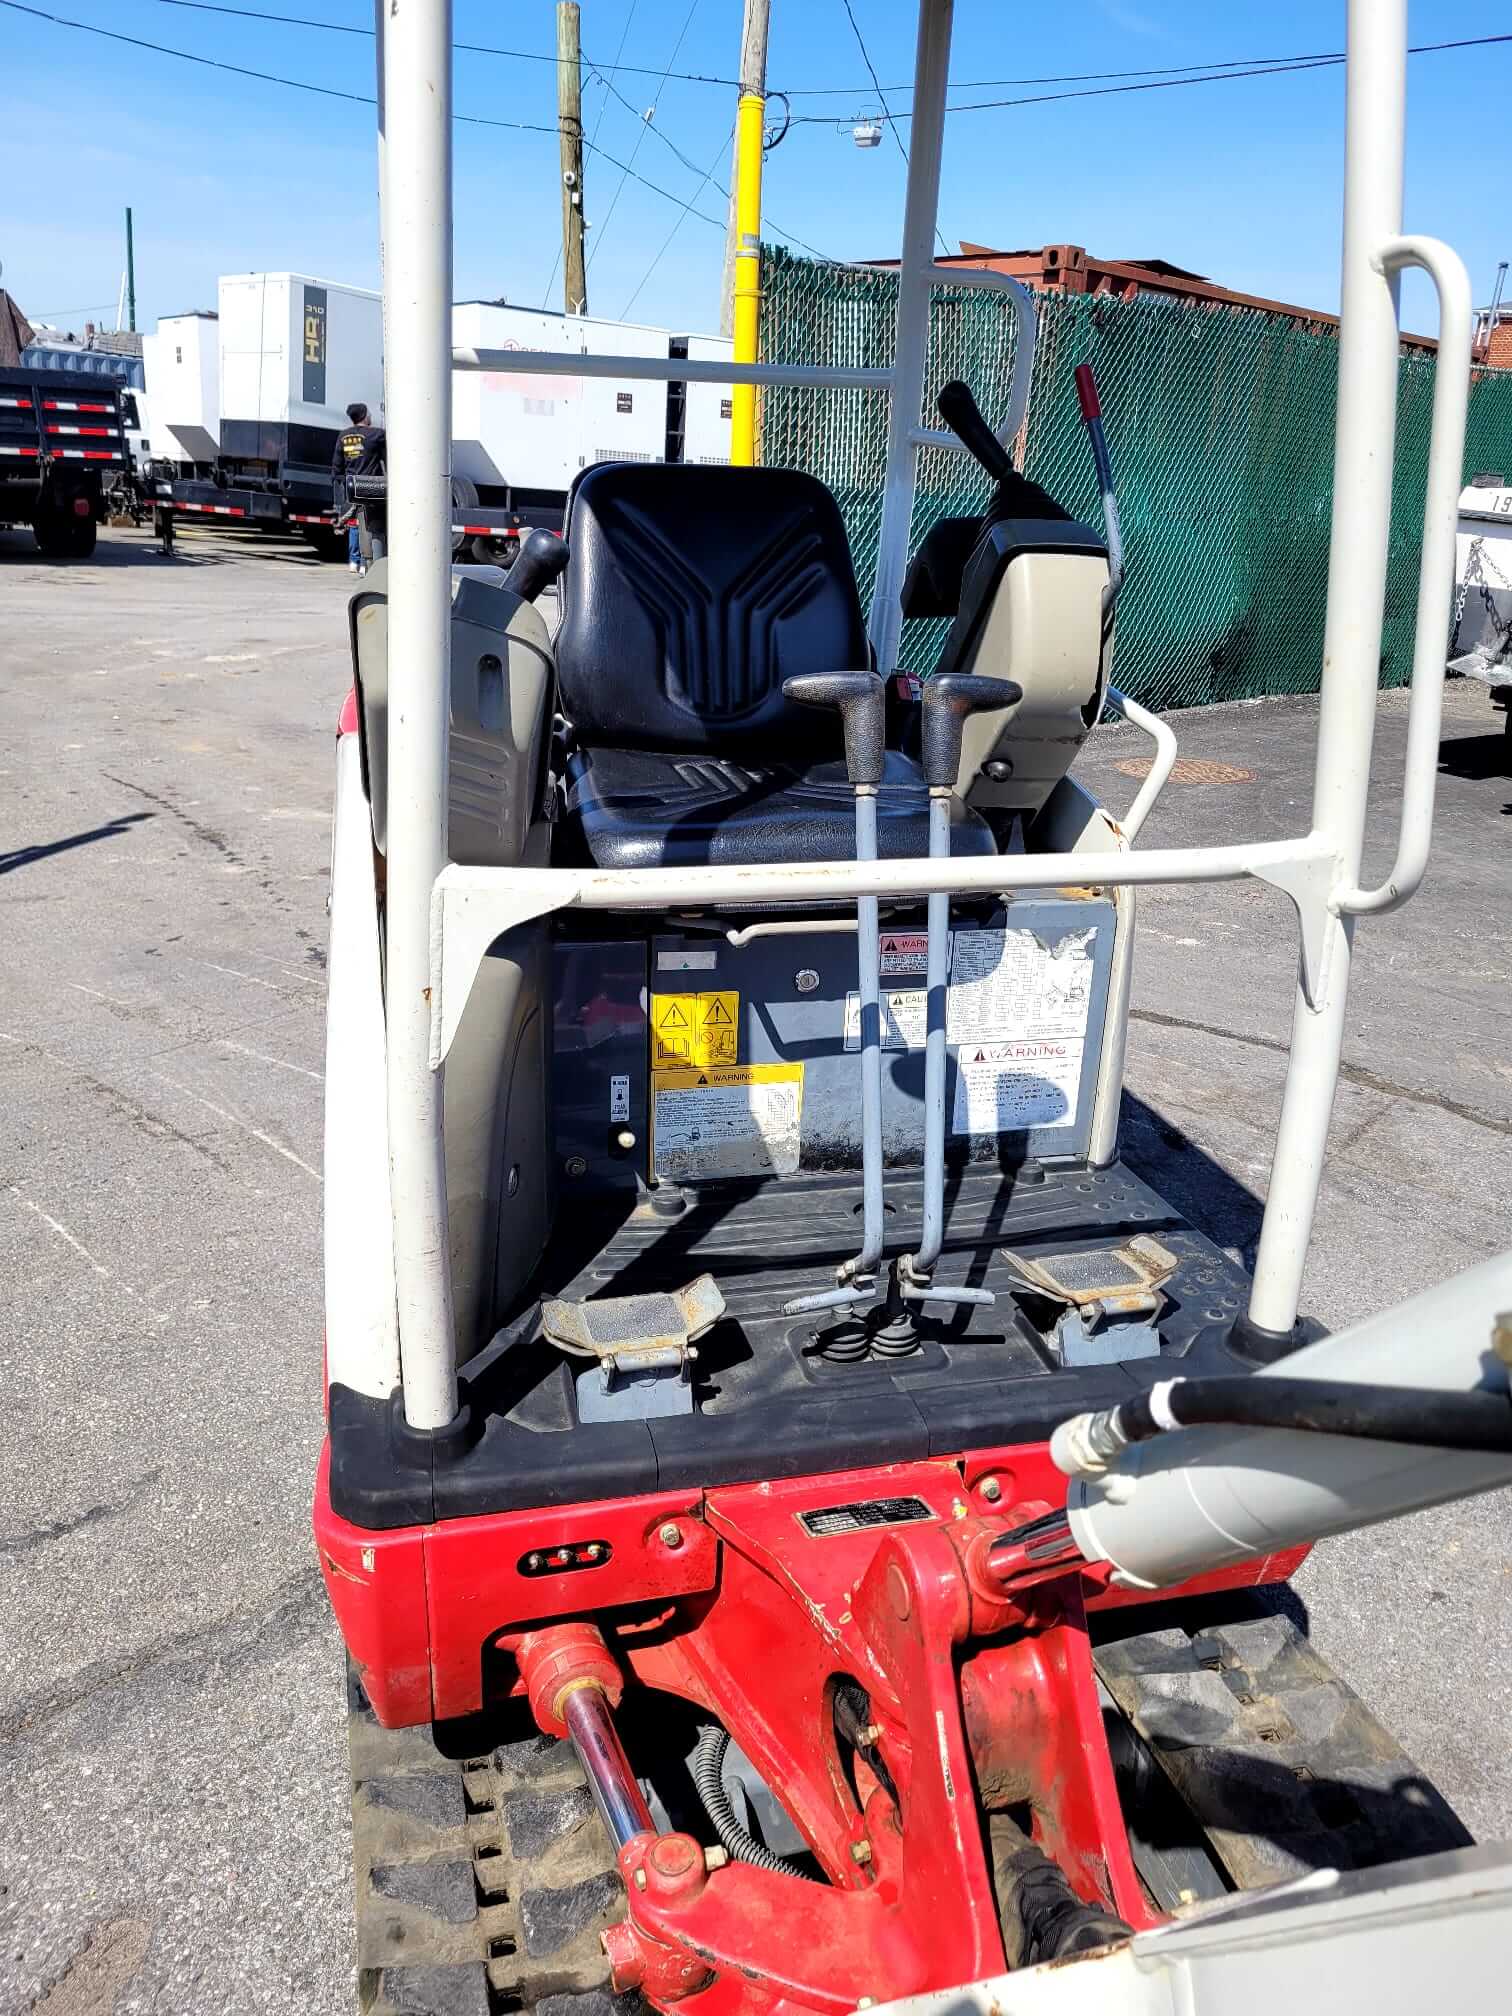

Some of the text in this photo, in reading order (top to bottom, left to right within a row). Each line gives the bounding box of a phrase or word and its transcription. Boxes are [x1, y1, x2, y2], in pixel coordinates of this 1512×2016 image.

[902, 939, 928, 949] WARN
[989, 1045, 1067, 1059] WARNING
[713, 1071, 755, 1082] WARNING
